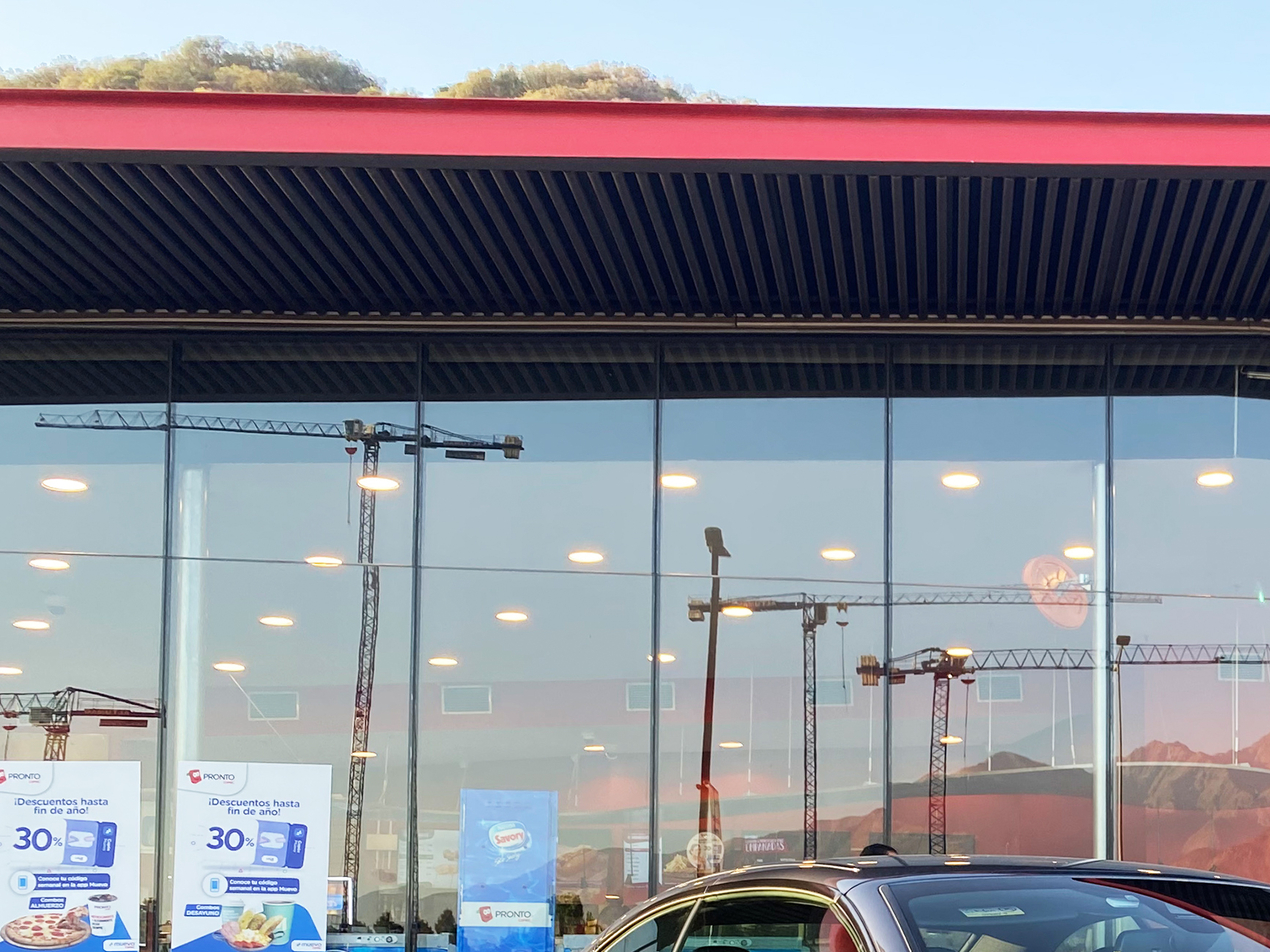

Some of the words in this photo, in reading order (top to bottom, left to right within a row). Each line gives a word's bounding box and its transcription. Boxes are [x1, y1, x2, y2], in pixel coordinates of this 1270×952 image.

[14, 798, 78, 806] ¡Descuentos
[208, 798, 270, 807] ¡Descuentos
[273, 800, 300, 808] hasta
[227, 807, 240, 815] fin
[259, 808, 280, 816] año!
[495, 832, 524, 844] Savory
